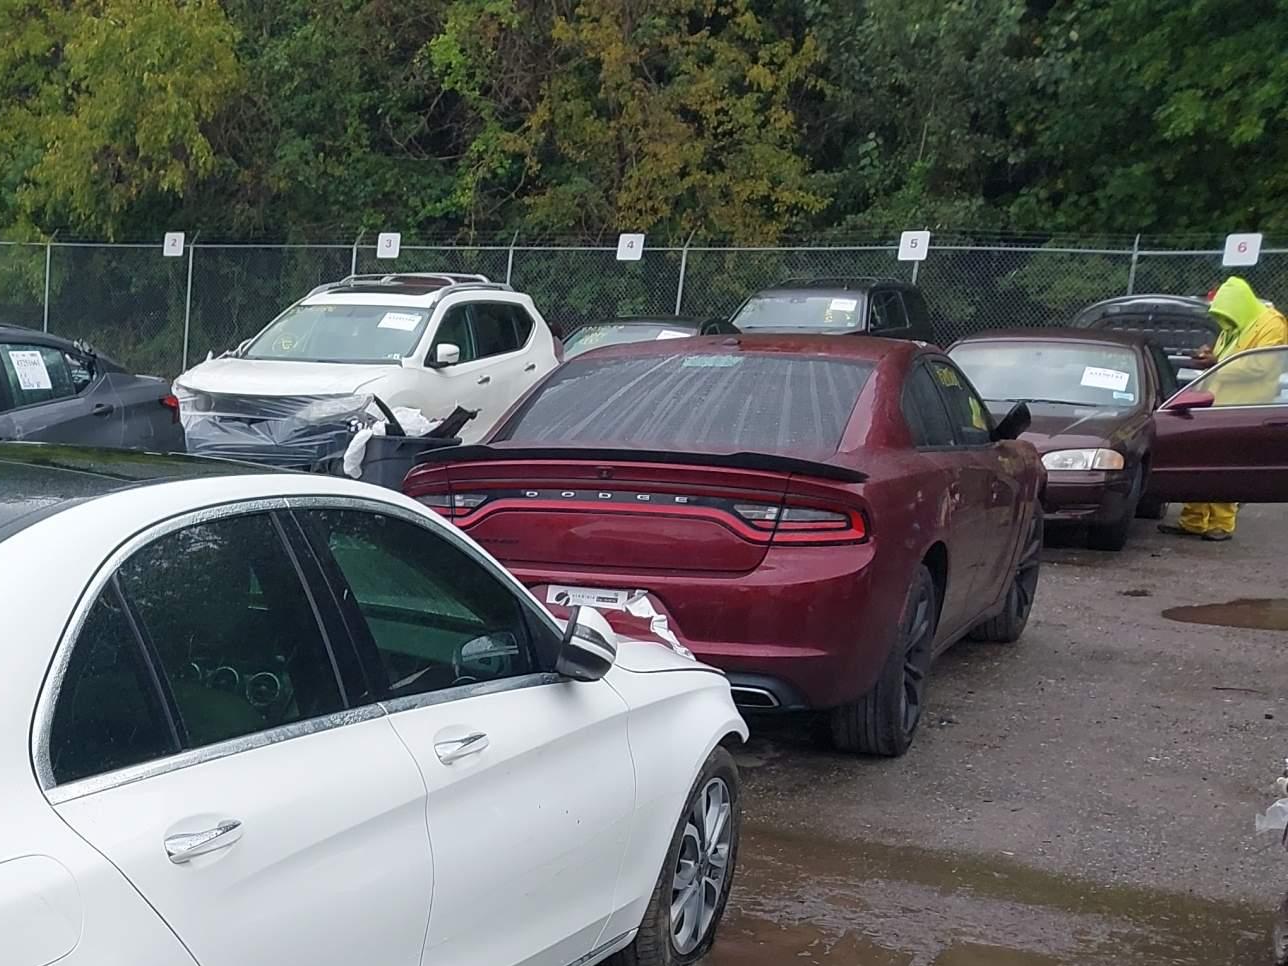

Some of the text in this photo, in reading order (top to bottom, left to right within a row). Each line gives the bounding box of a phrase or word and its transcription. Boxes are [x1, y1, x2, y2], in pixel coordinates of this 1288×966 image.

[909, 238, 918, 248] 5
[1237, 241, 1248, 253] 6
[524, 490, 689, 504] DODGE
